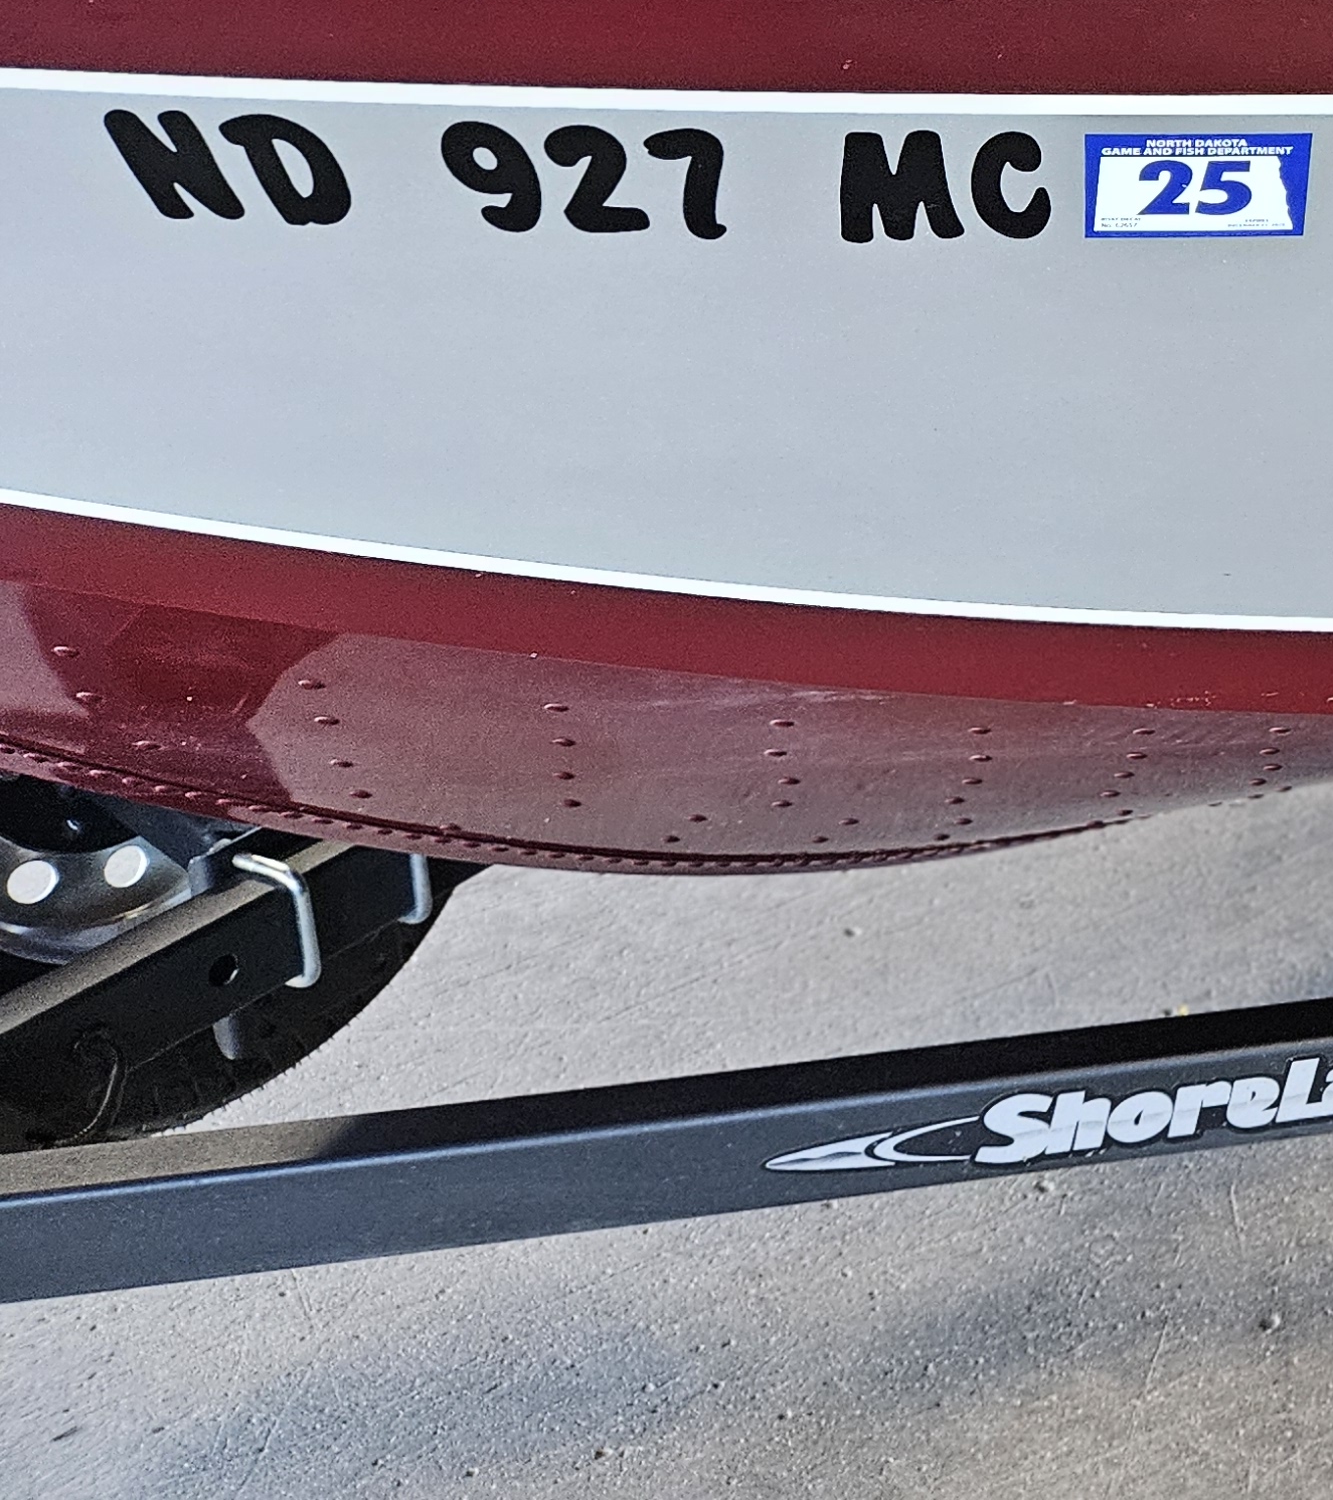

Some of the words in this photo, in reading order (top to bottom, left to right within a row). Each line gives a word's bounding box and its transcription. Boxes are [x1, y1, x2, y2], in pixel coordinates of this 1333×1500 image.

[1101, 147, 1141, 156] GAME
[1143, 147, 1173, 156] AND
[1175, 147, 1205, 156] FISH
[1207, 146, 1294, 156] DEPARTMENT
[1146, 139, 1192, 148] NORTH
[1194, 139, 1249, 148] DAKOTA
[104, 109, 351, 226] ND
[441, 120, 727, 240] 927
[840, 130, 1051, 244] MC
[1137, 160, 1252, 215] 25
